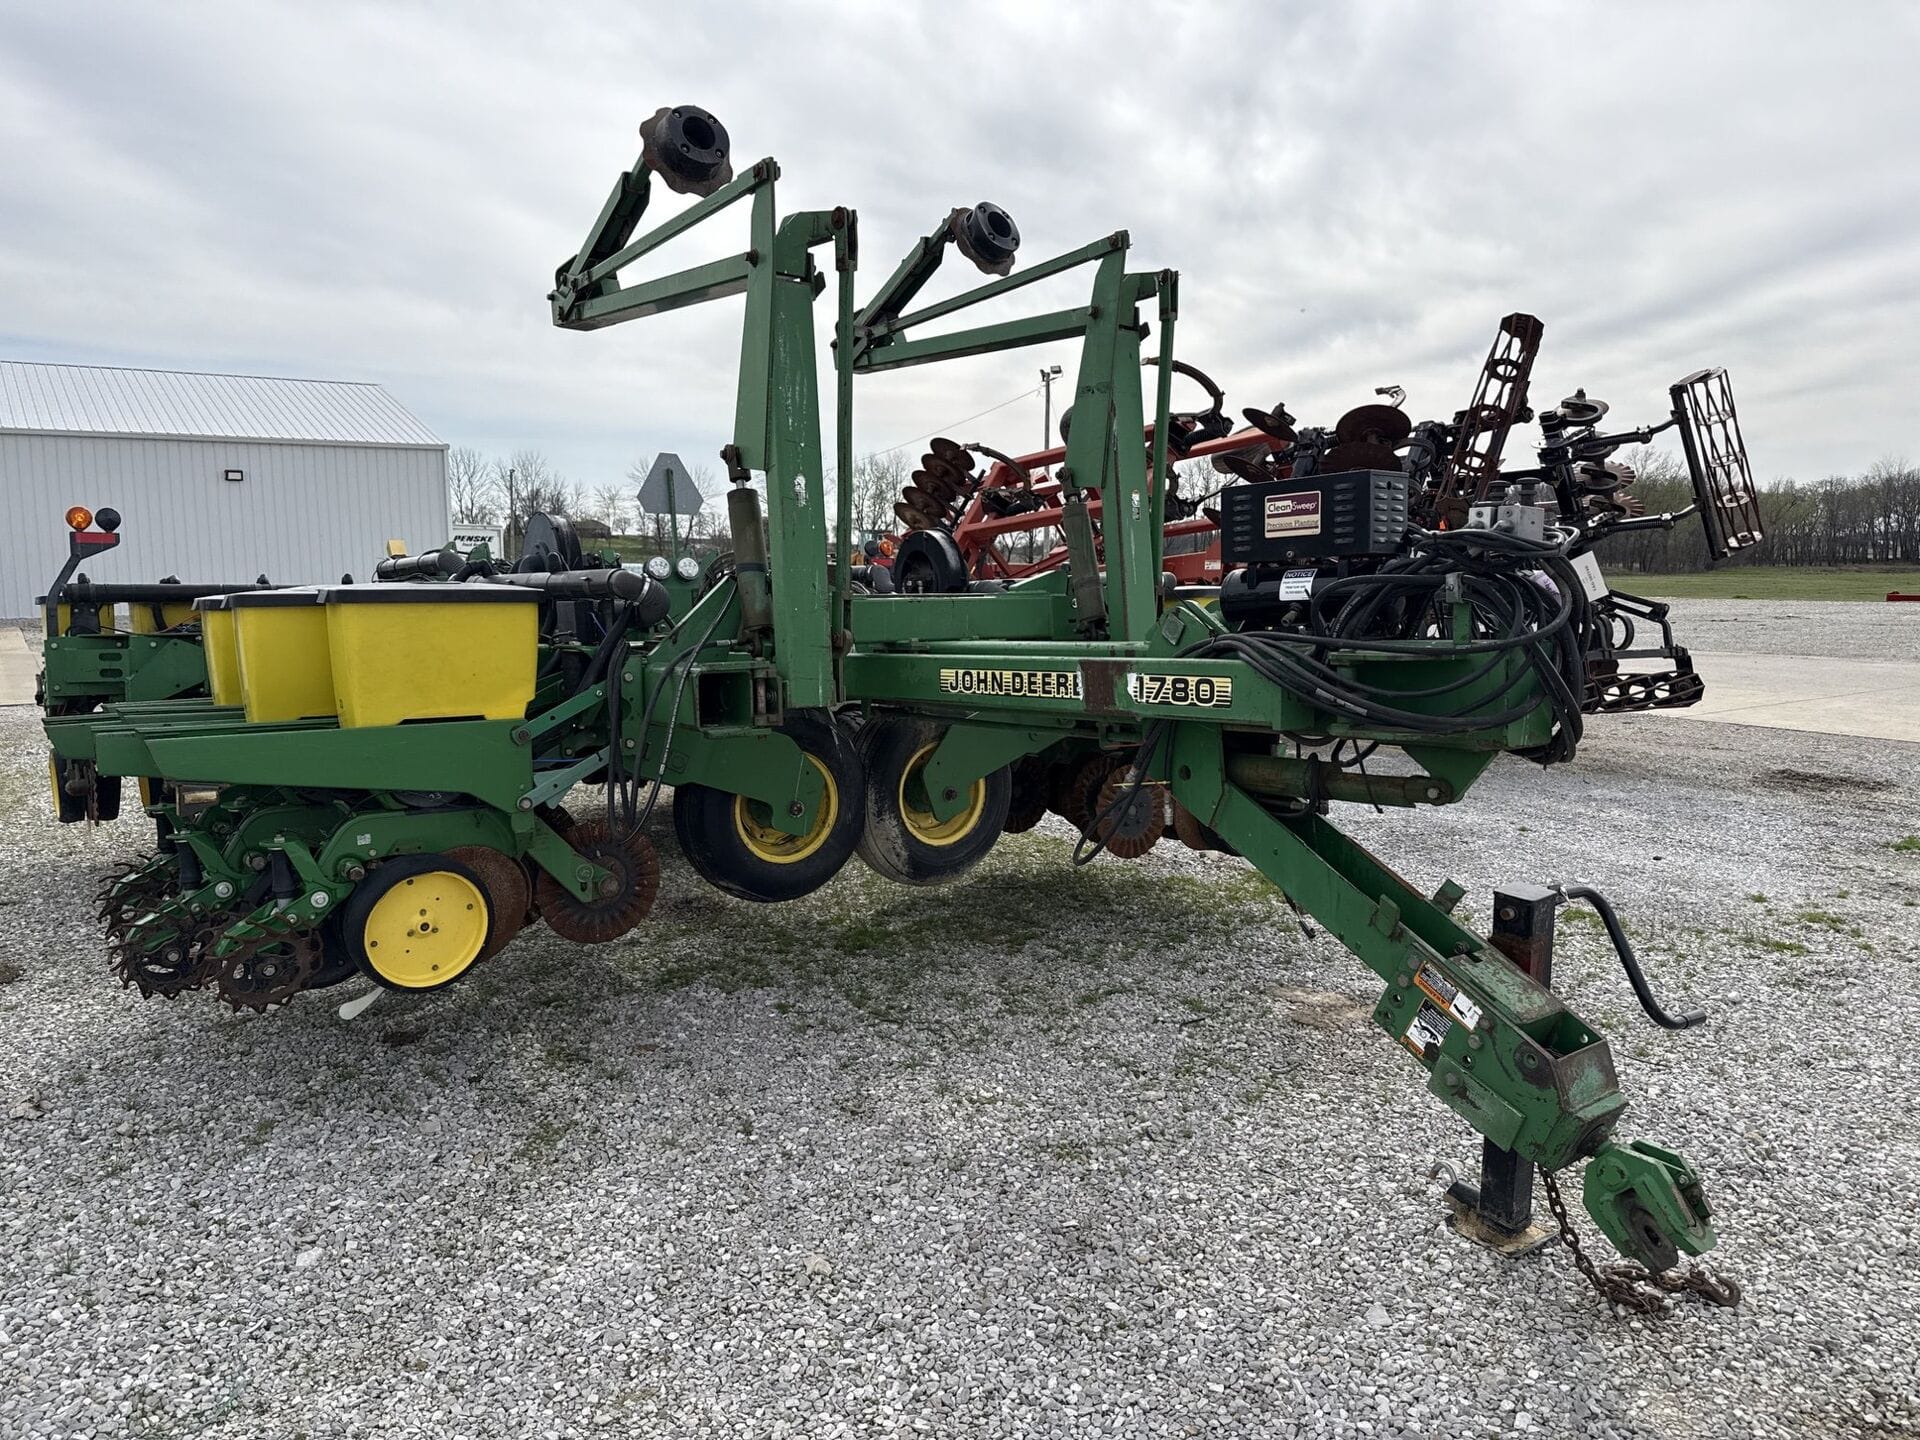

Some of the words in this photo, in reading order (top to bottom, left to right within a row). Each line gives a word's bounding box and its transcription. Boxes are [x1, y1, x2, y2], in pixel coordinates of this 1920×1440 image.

[1267, 521, 1293, 530] Precision
[1294, 519, 1319, 528] Planting
[454, 535, 494, 543] PENSKE
[1285, 570, 1313, 578] NOTICE
[948, 670, 1004, 694] JOHN
[1136, 676, 1216, 706] 1780
